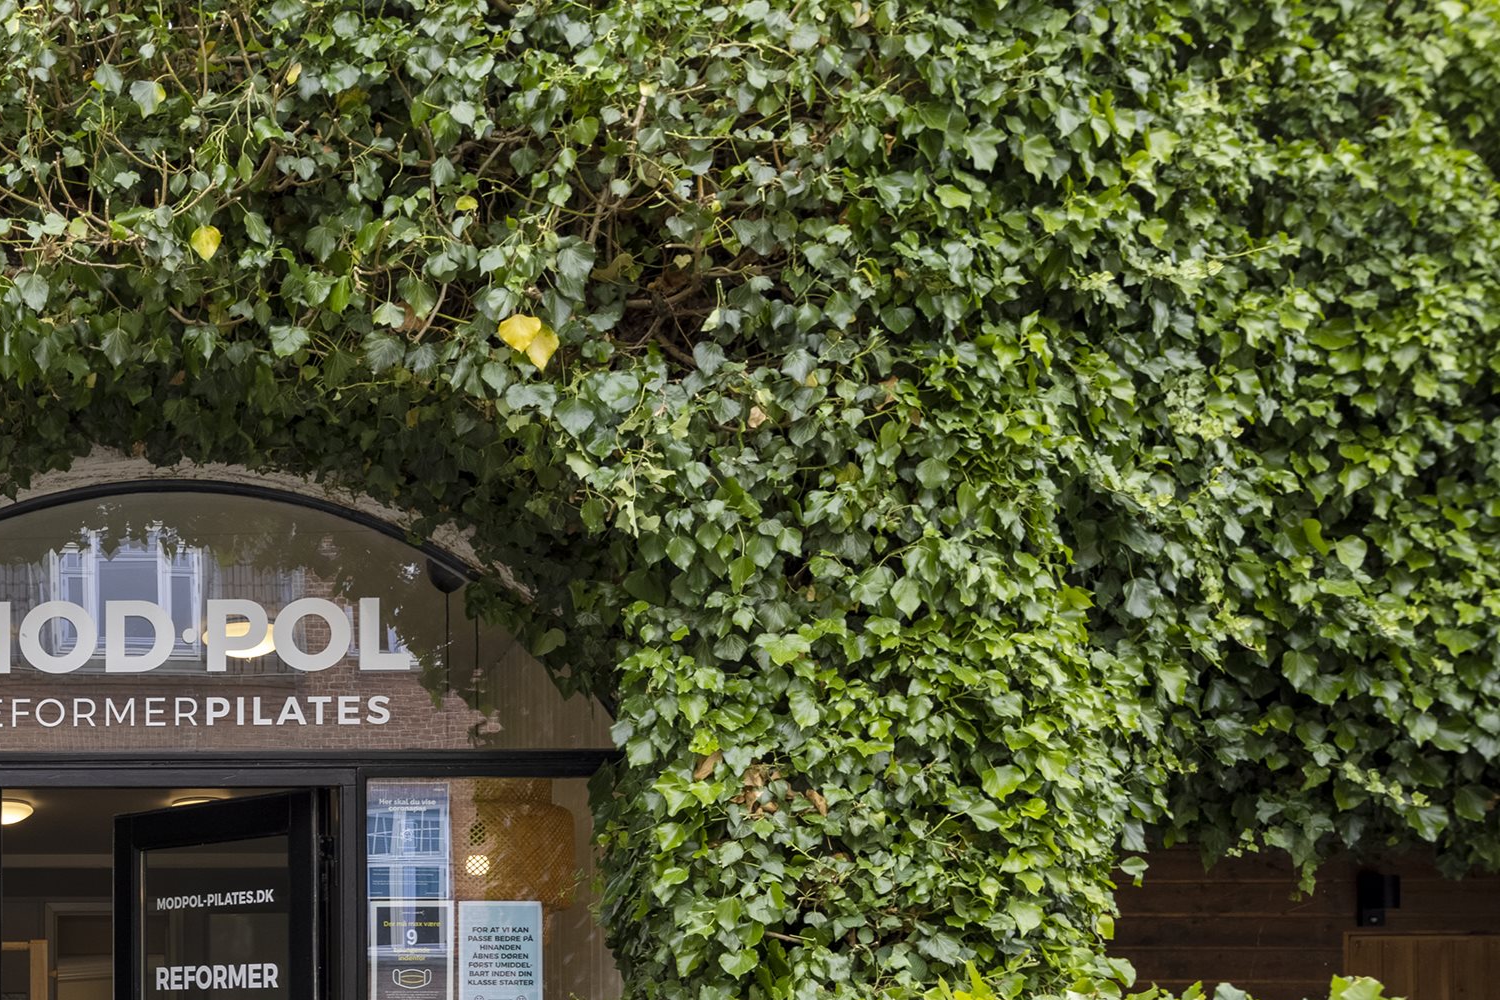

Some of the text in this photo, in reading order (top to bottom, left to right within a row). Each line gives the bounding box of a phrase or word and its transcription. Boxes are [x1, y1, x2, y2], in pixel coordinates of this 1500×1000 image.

[156, 889, 275, 911] MODPOL-PILATES.DK
[406, 929, 418, 945] 9
[522, 934, 534, 942] PÅ
[472, 952, 529, 960] ÅBNES DØREN
[155, 962, 279, 991] REFORMER
